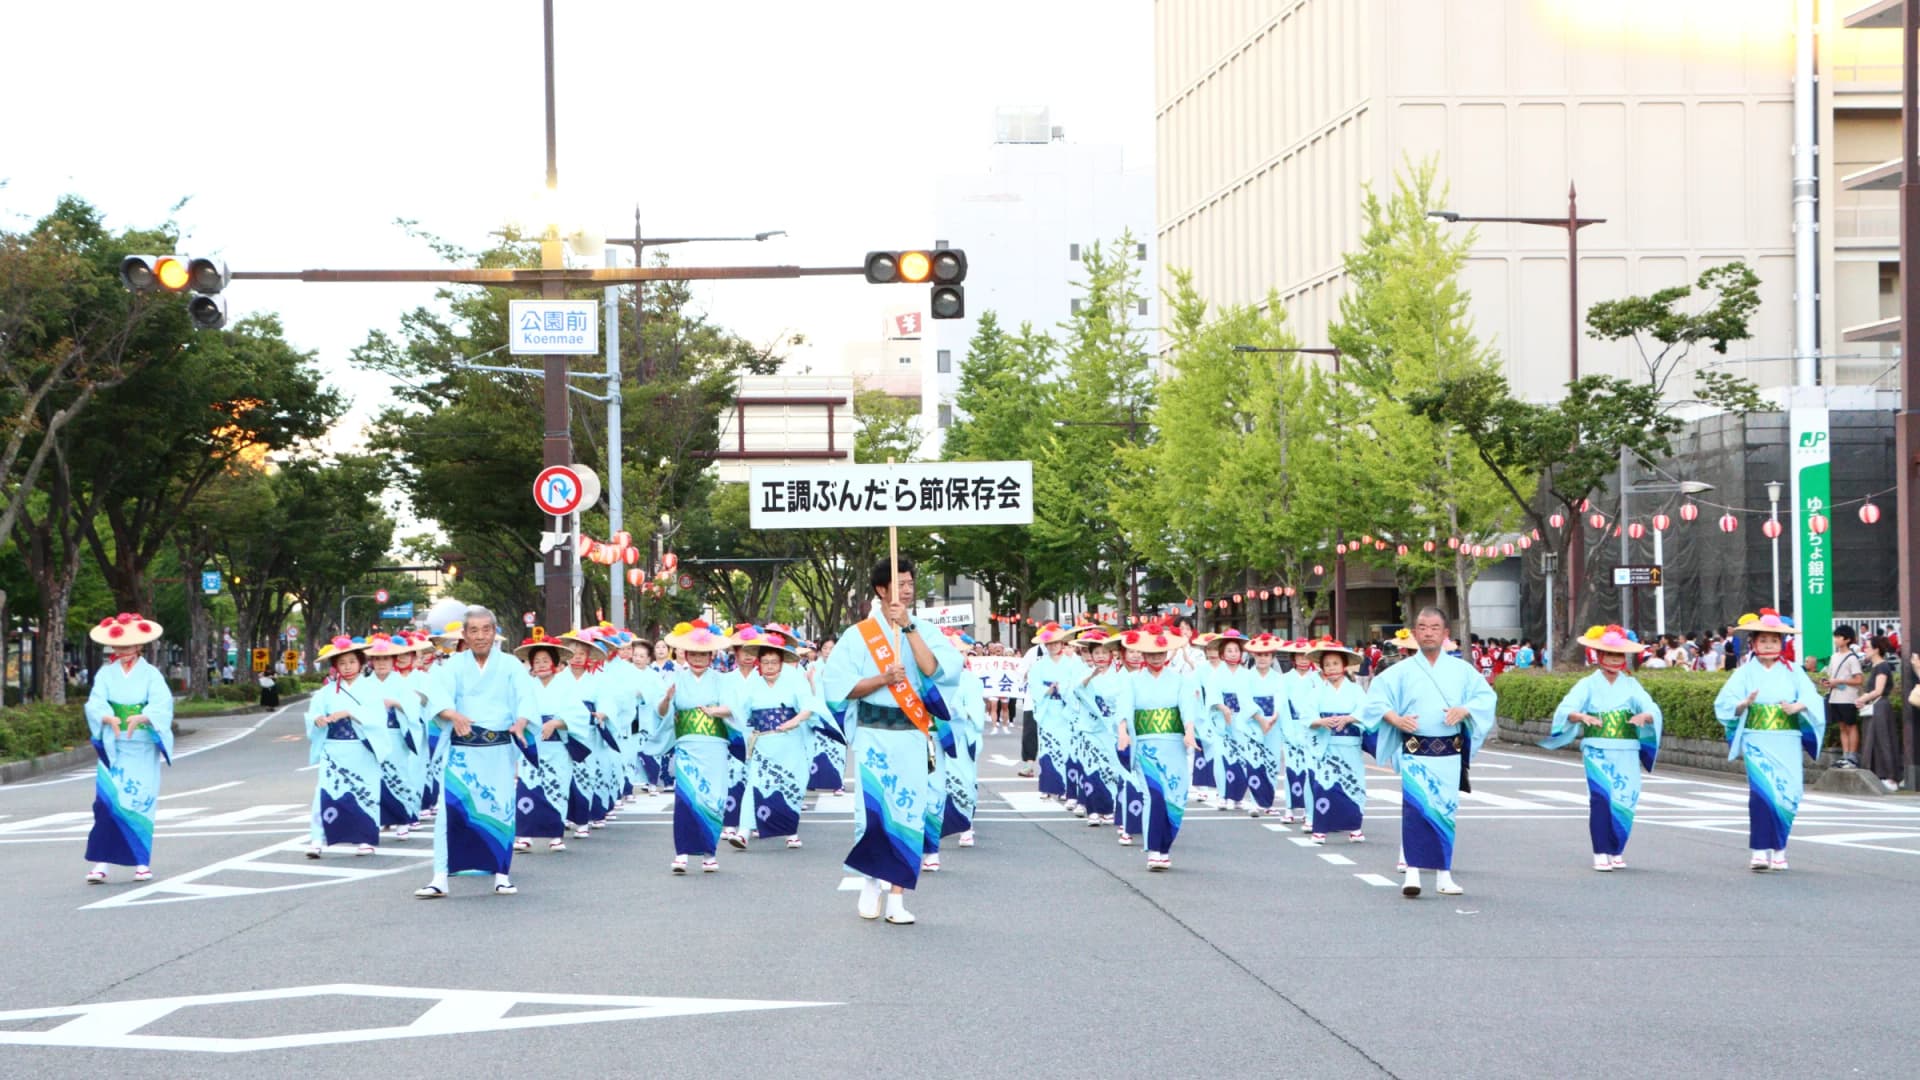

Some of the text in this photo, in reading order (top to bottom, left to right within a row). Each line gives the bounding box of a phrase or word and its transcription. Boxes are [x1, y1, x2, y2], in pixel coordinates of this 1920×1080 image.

[521, 310, 587, 331] 公園前
[524, 333, 584, 344] Koenmae
[1799, 432, 1827, 447] JP
[761, 476, 1021, 513] 正調ぶんだら節保存会
[1807, 496, 1825, 595] ゆちょ銀行
